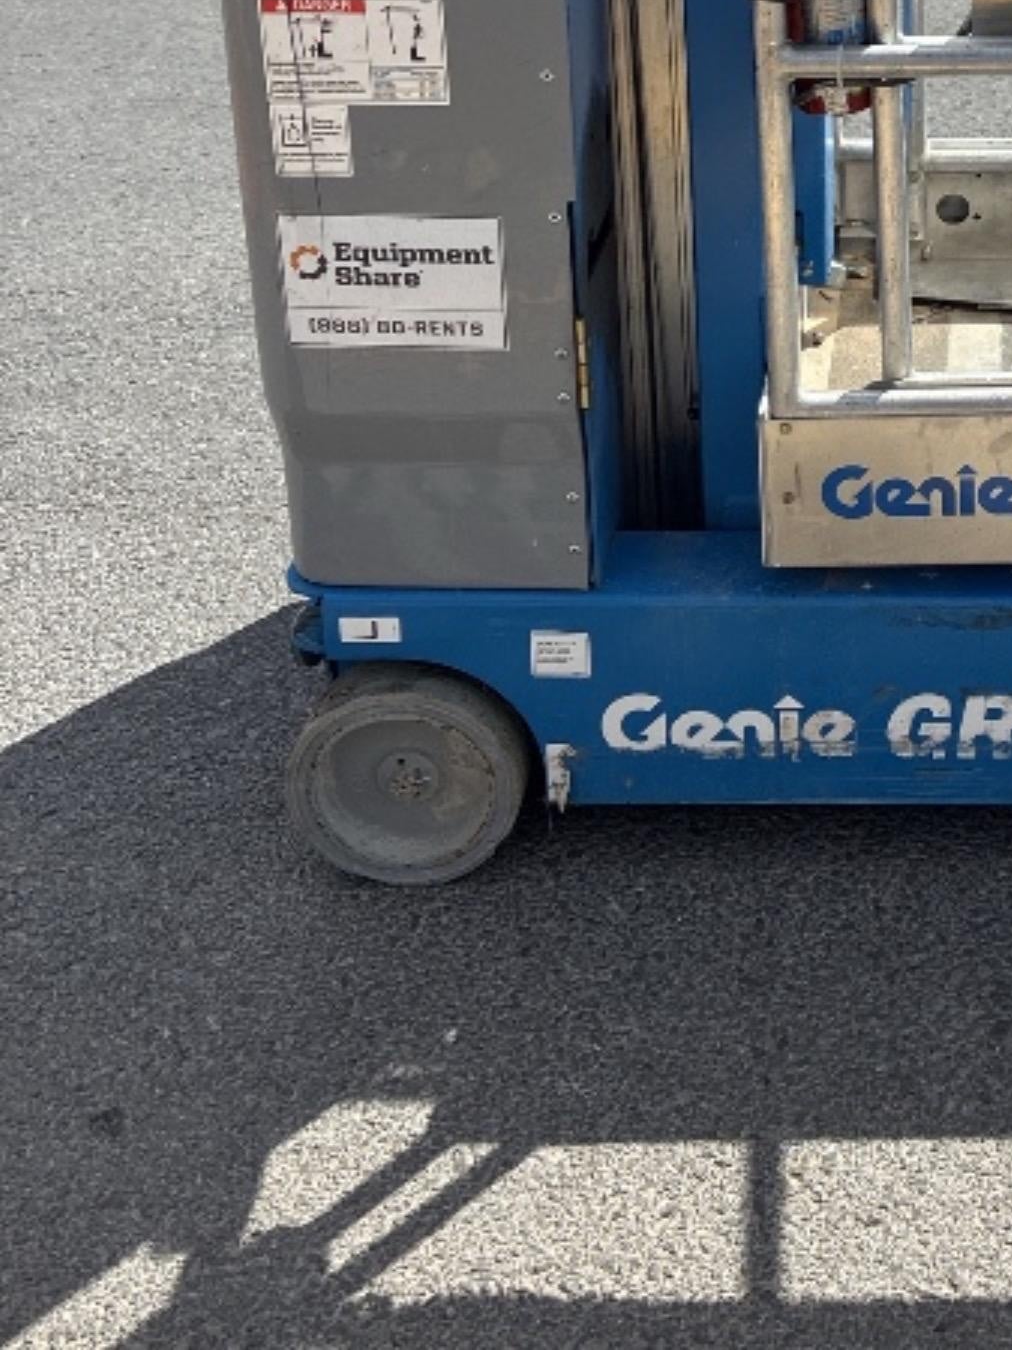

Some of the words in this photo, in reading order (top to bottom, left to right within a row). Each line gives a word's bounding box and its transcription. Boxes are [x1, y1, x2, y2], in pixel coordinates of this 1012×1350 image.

[333, 242, 495, 267] Equipment
[335, 267, 423, 288] Share
[602, 693, 856, 760] Genie
